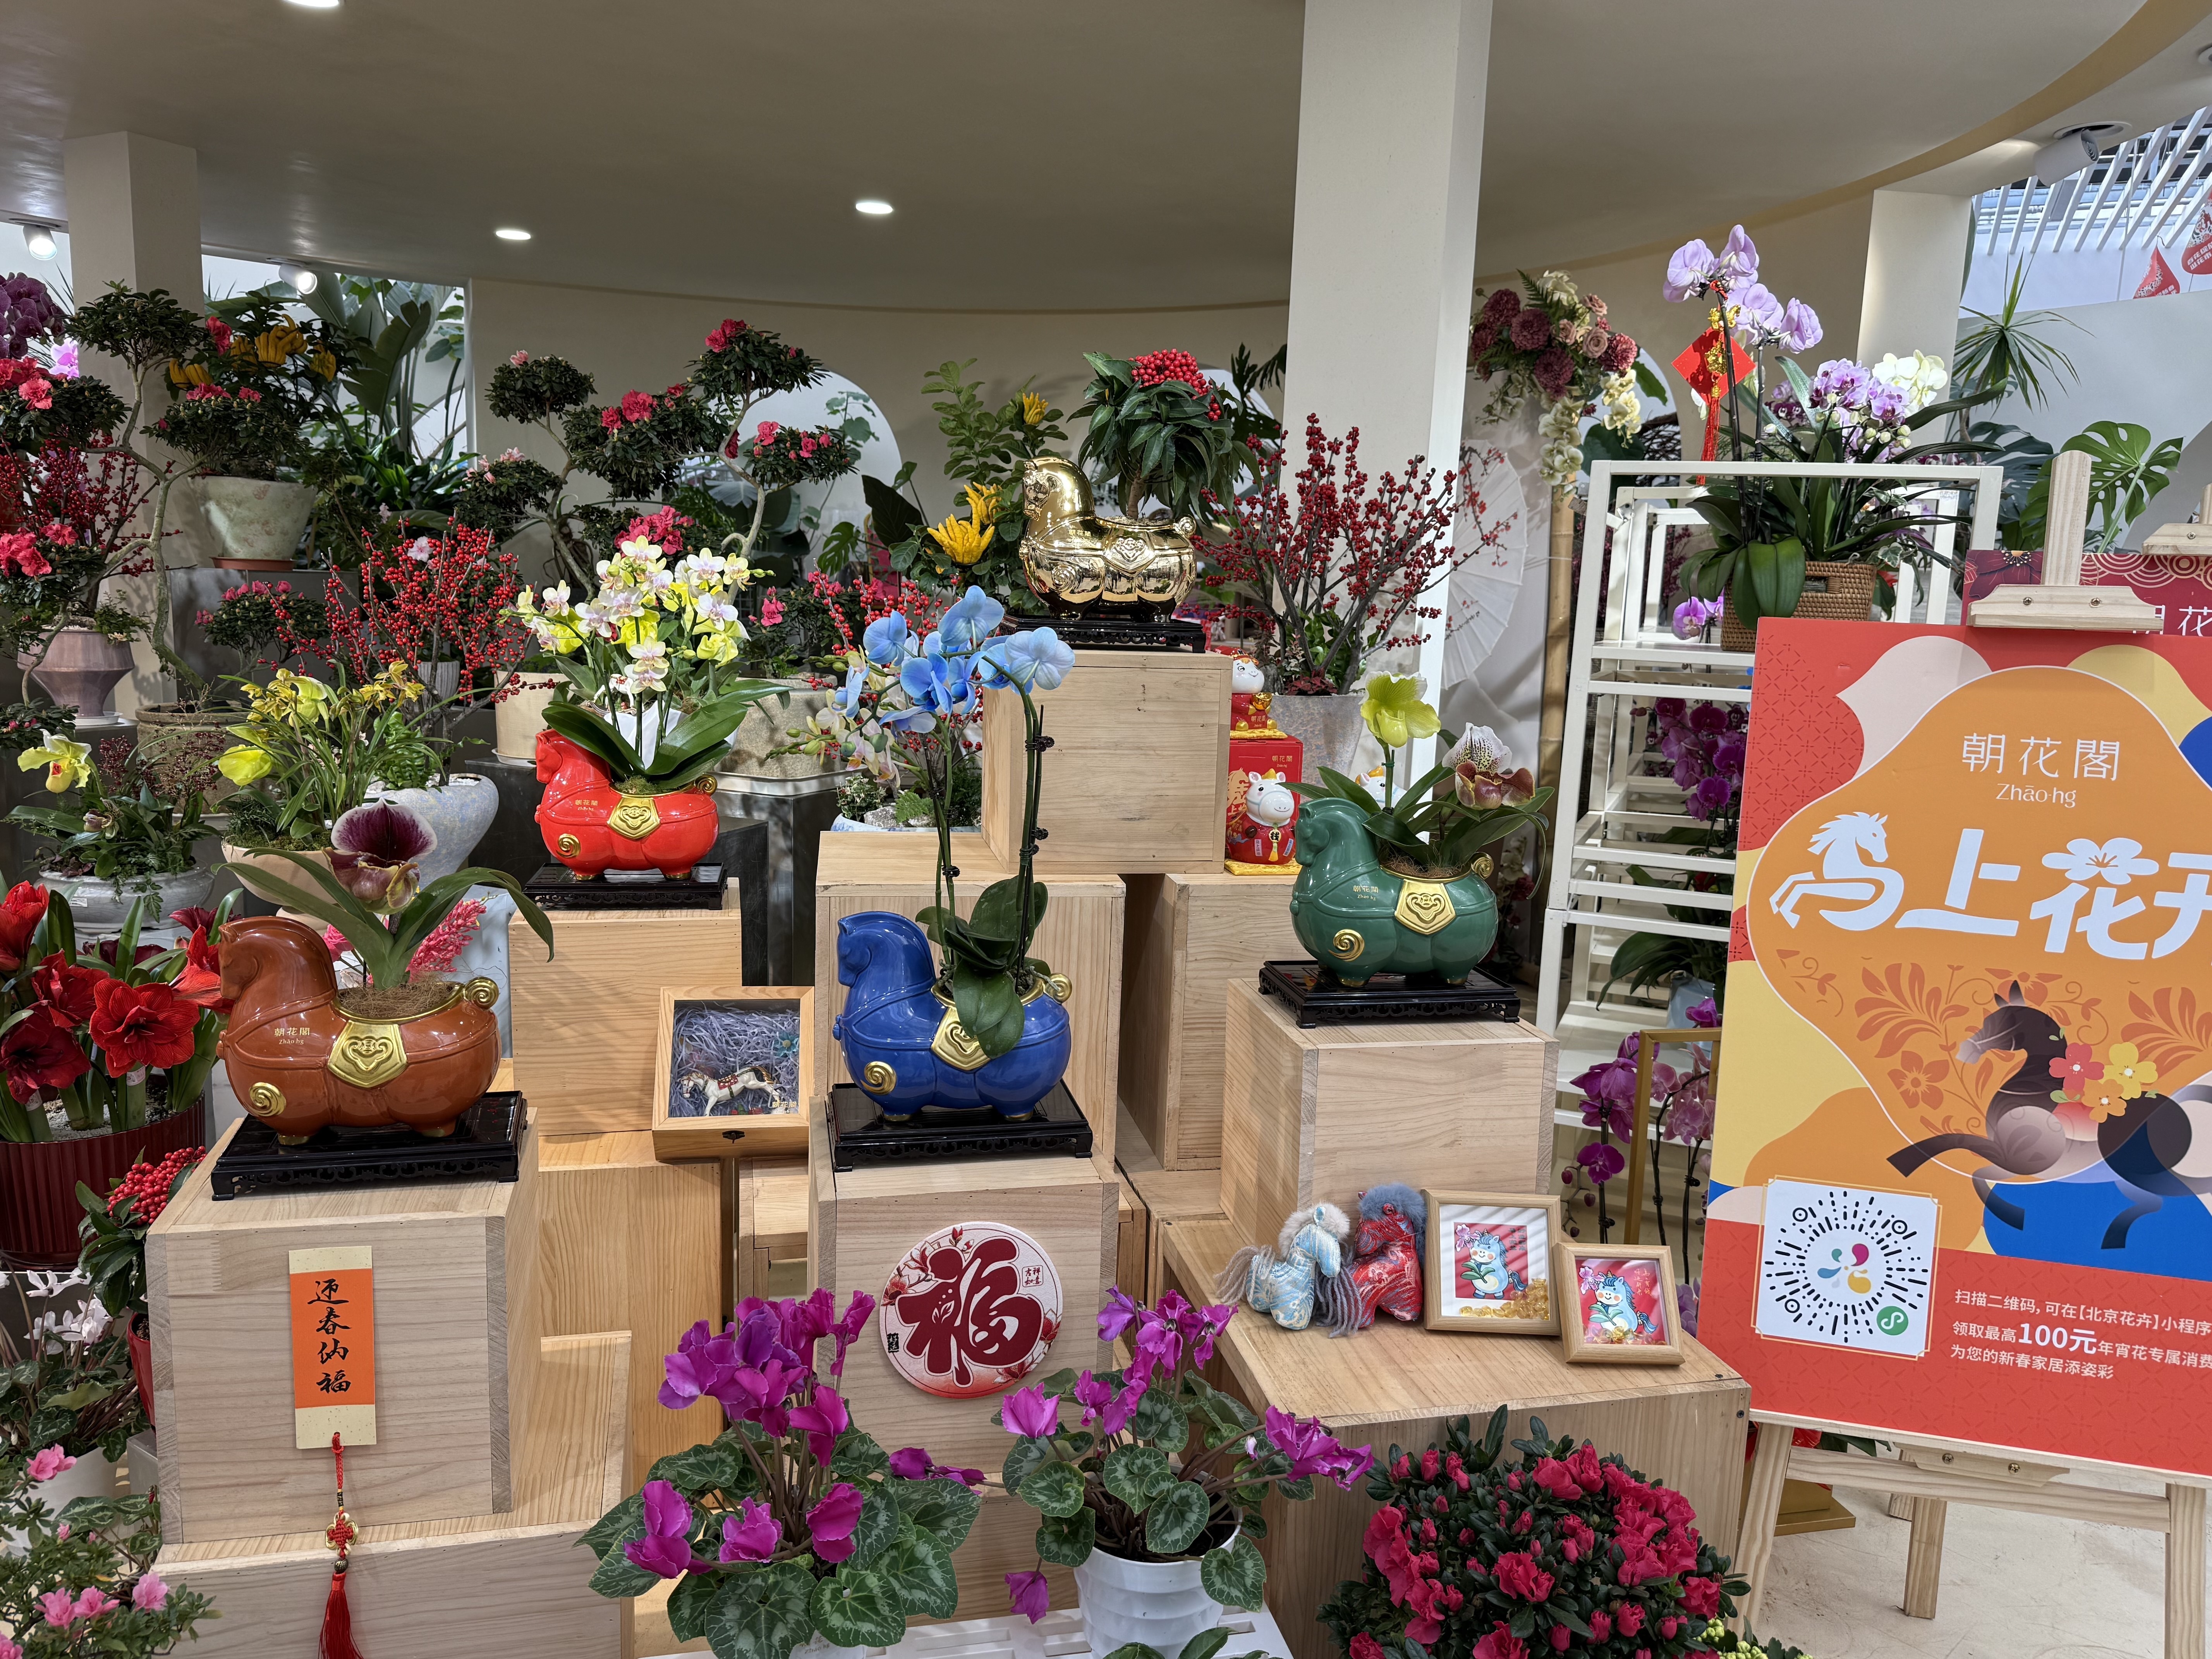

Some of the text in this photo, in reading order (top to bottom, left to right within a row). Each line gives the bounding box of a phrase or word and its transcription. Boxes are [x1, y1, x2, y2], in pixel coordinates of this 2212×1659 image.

[895, 1237, 1044, 1386] 福
[1951, 1344, 2114, 1379] 为您的新春家居添姿彩
